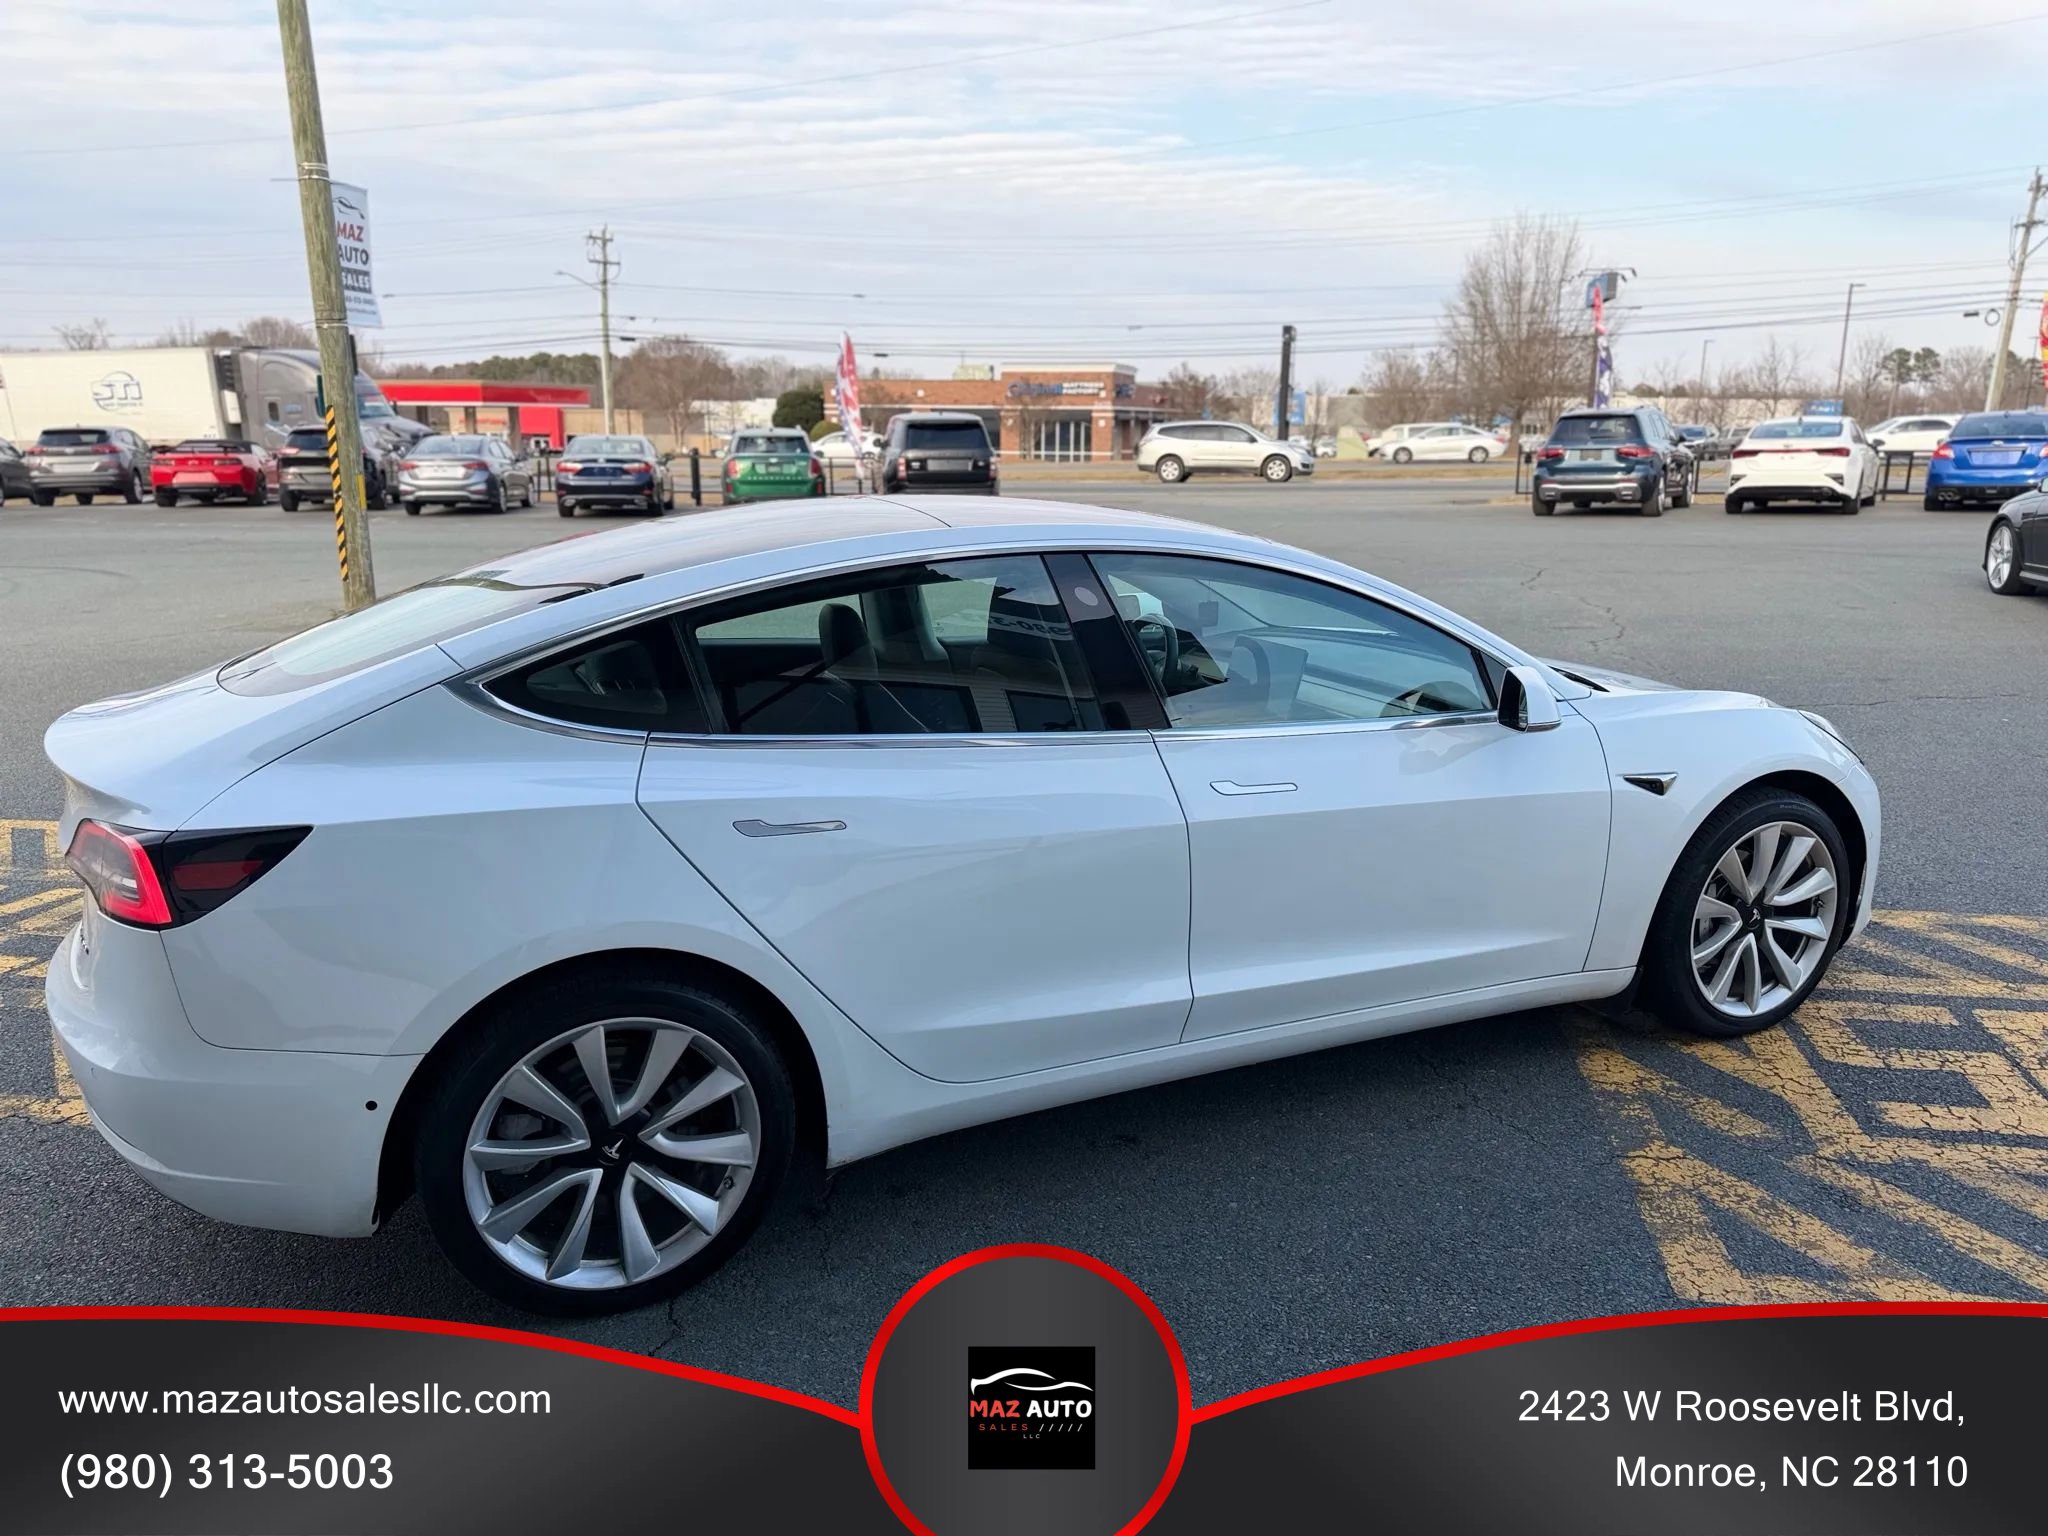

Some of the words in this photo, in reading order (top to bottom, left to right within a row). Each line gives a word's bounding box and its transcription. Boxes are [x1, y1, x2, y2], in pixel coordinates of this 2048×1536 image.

[336, 220, 364, 242] MAZ
[338, 244, 370, 266] AUTO
[342, 272, 370, 288] SALES
